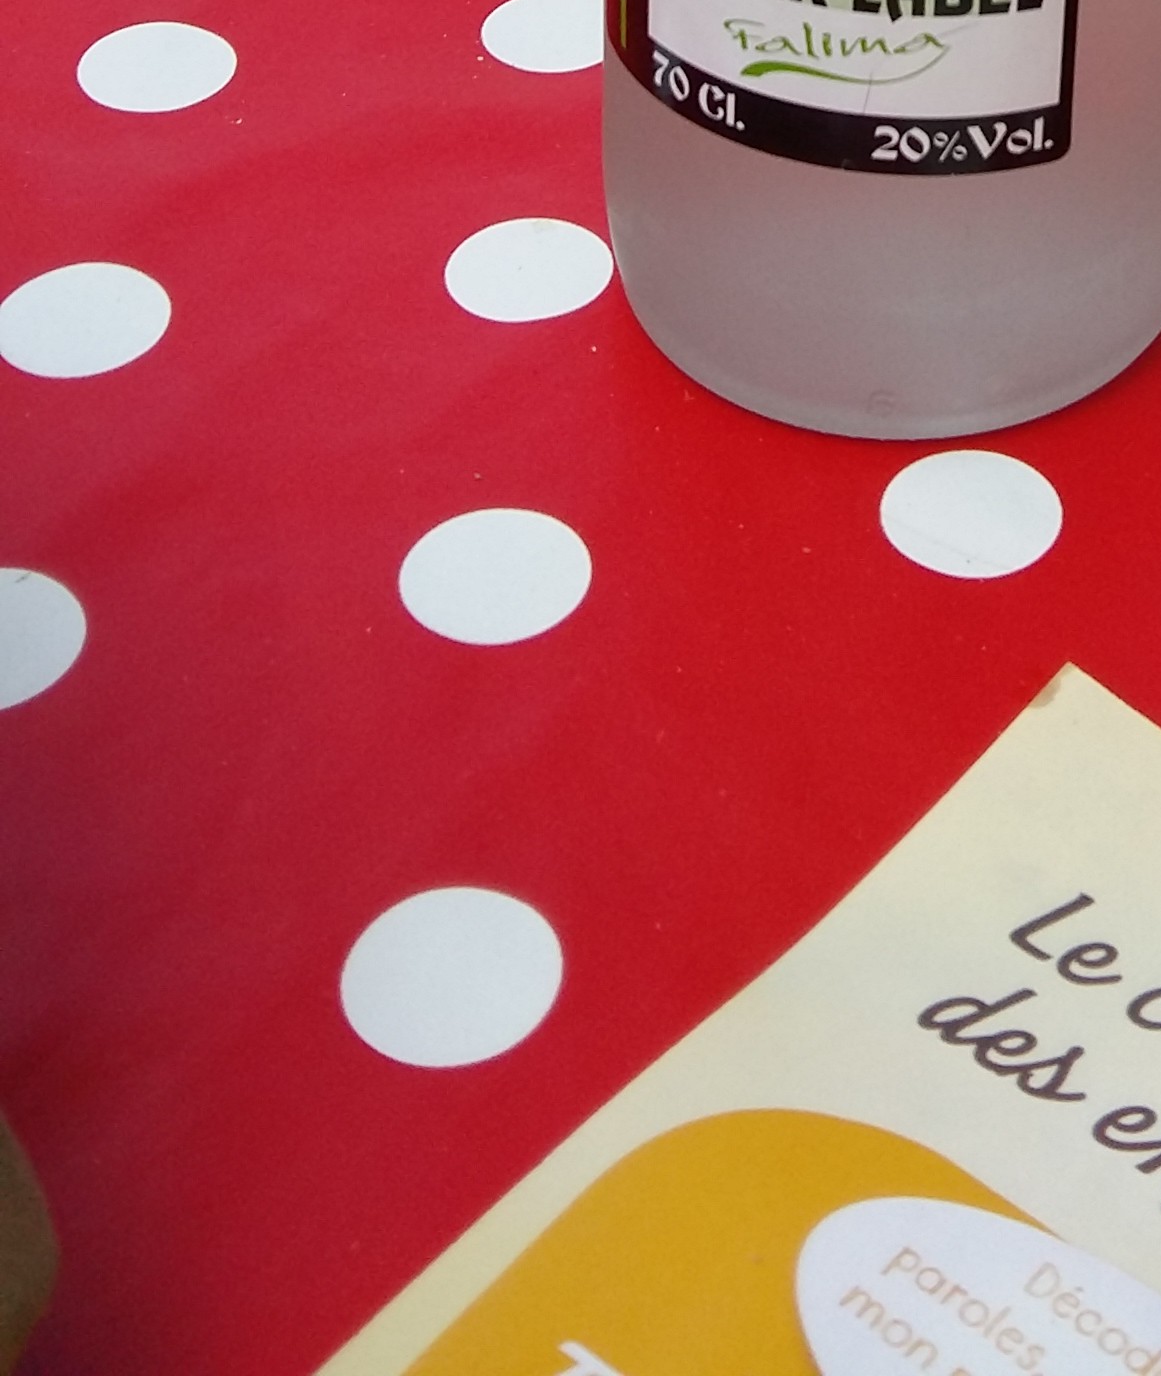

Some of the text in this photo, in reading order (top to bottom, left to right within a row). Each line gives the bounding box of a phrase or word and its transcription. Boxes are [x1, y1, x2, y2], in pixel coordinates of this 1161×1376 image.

[651, 49, 690, 102] 70
[723, 17, 947, 62] Falima
[1008, 893, 1123, 986] Le
[917, 988, 1087, 1102] des
[838, 1284, 939, 1371] mon
